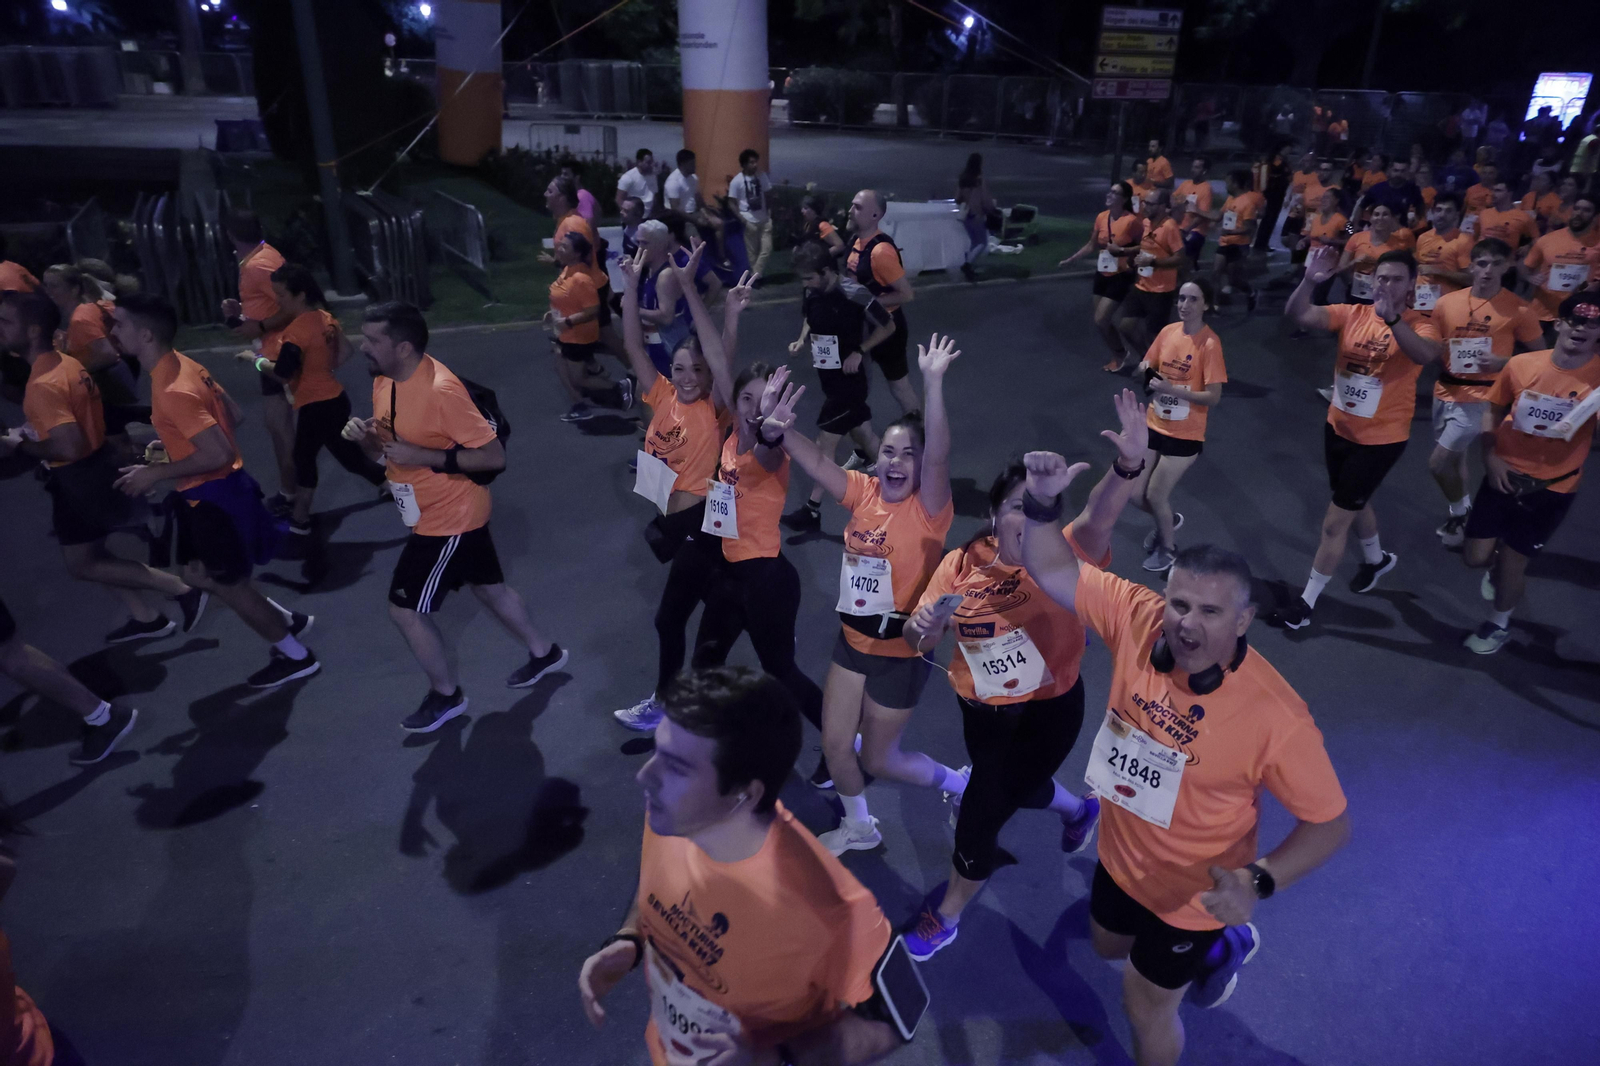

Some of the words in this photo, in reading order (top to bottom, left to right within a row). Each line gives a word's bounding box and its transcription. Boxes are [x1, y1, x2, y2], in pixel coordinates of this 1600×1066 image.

[1160, 395, 1179, 406] 4096
[1344, 385, 1368, 400] 3945
[1528, 405, 1564, 422] 20502
[709, 499, 729, 516] 15168
[850, 575, 879, 594] 14702
[982, 650, 1027, 676] 15314
[1149, 700, 1199, 739] NOCTURNA
[1164, 724, 1194, 746] KH7
[1107, 746, 1162, 789] 21848
[648, 893, 688, 941] SEVILLA
[670, 904, 724, 958] NOCTURNA
